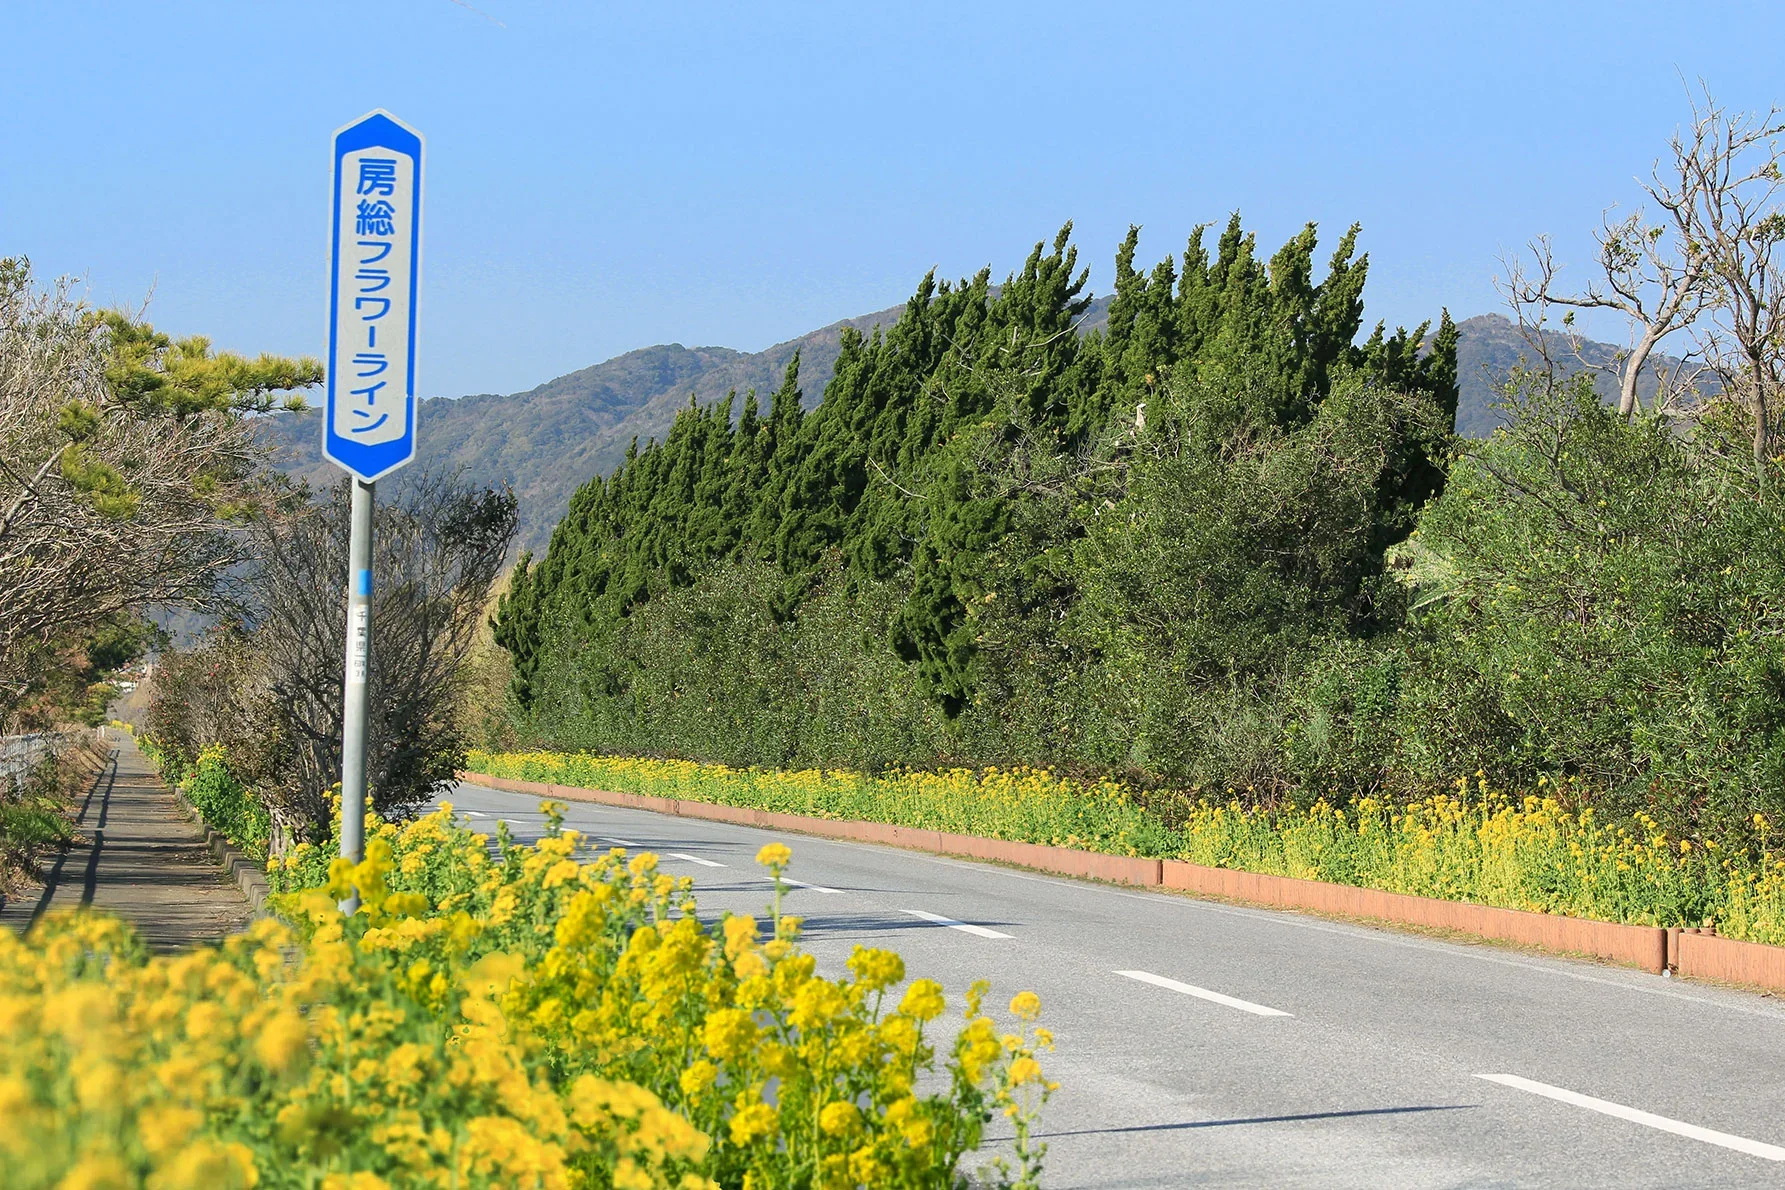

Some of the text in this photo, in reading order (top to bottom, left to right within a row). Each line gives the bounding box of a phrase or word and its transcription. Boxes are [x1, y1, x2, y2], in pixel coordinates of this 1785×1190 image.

[350, 157, 397, 434] 房総フラワーライン
